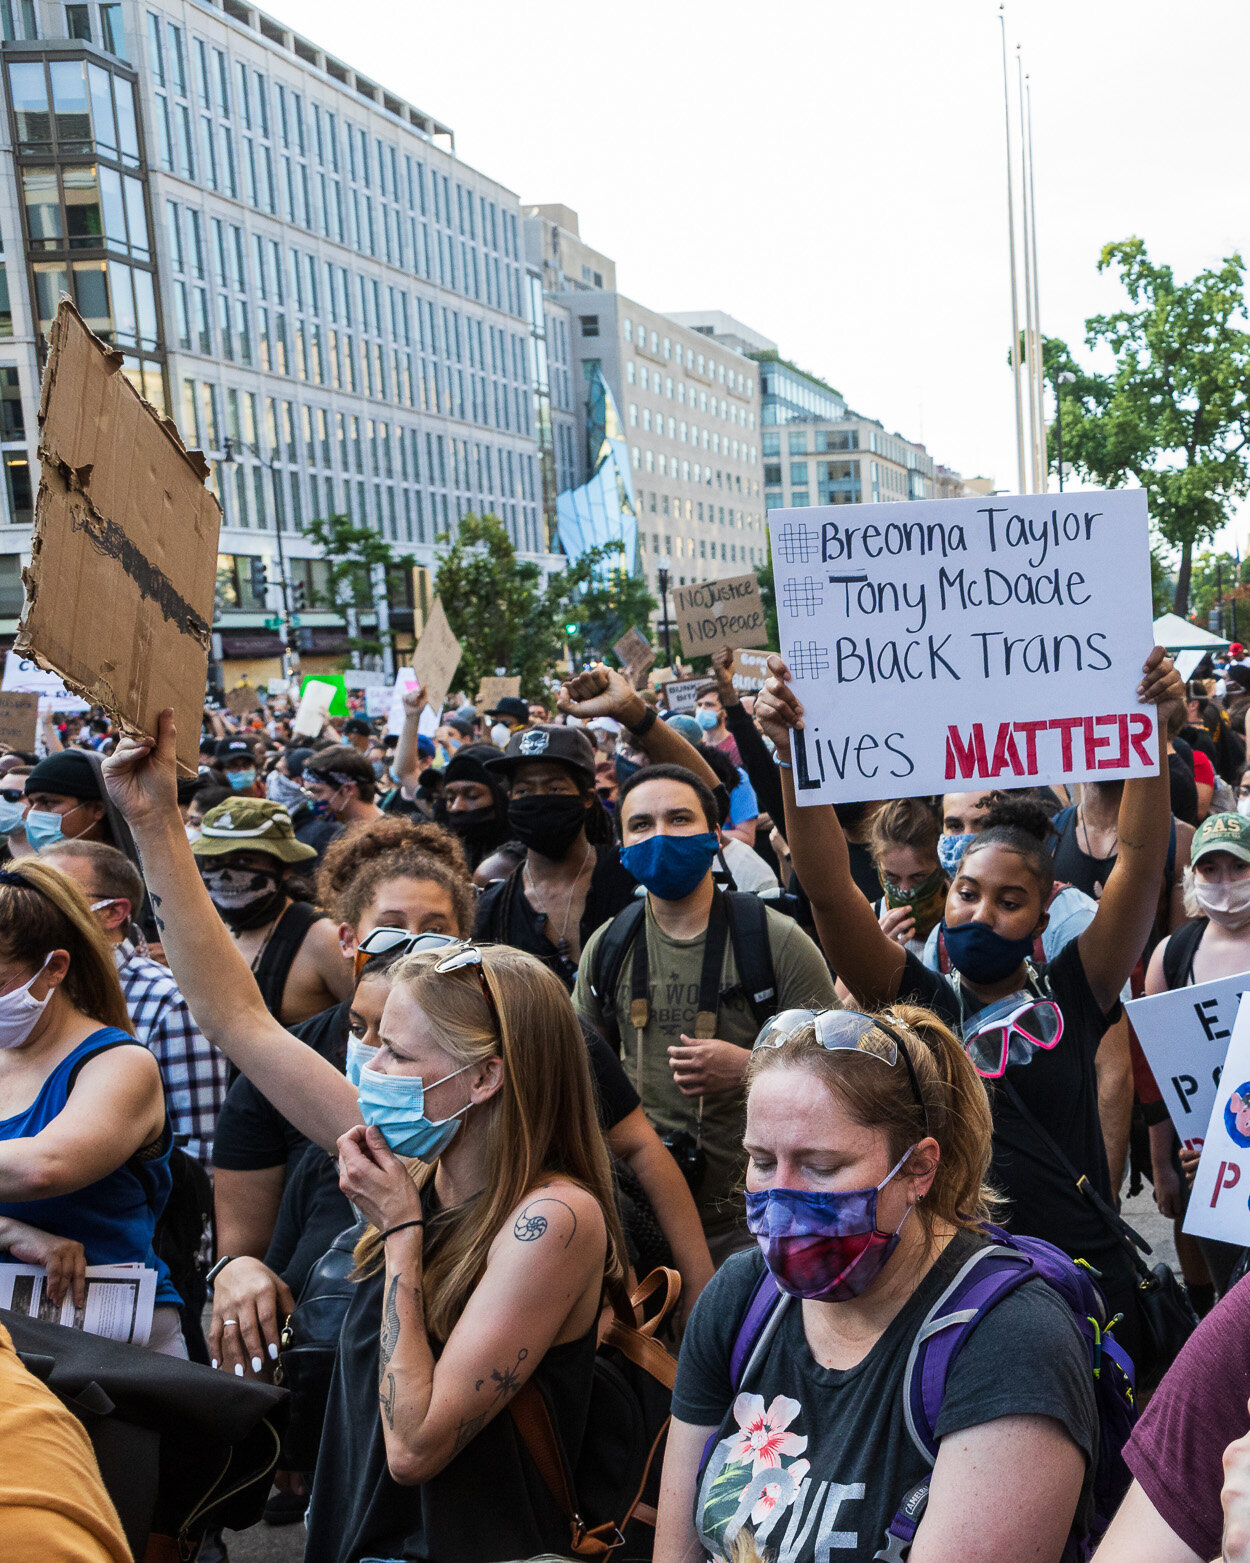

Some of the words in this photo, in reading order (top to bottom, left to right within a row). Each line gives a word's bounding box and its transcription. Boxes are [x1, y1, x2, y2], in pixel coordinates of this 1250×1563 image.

[778, 521, 968, 563] #Breonna
[976, 508, 1103, 568] Taylor
[701, 580, 755, 608] Justice
[783, 568, 926, 634] #Tony
[938, 566, 1092, 611] McDade
[717, 611, 766, 637] Peace
[971, 631, 1112, 679] Trans
[793, 727, 915, 791] Lives
[944, 713, 1154, 780] MATTER
[1202, 818, 1241, 837] SAS
[905, 1485, 929, 1515] CAMELBA
